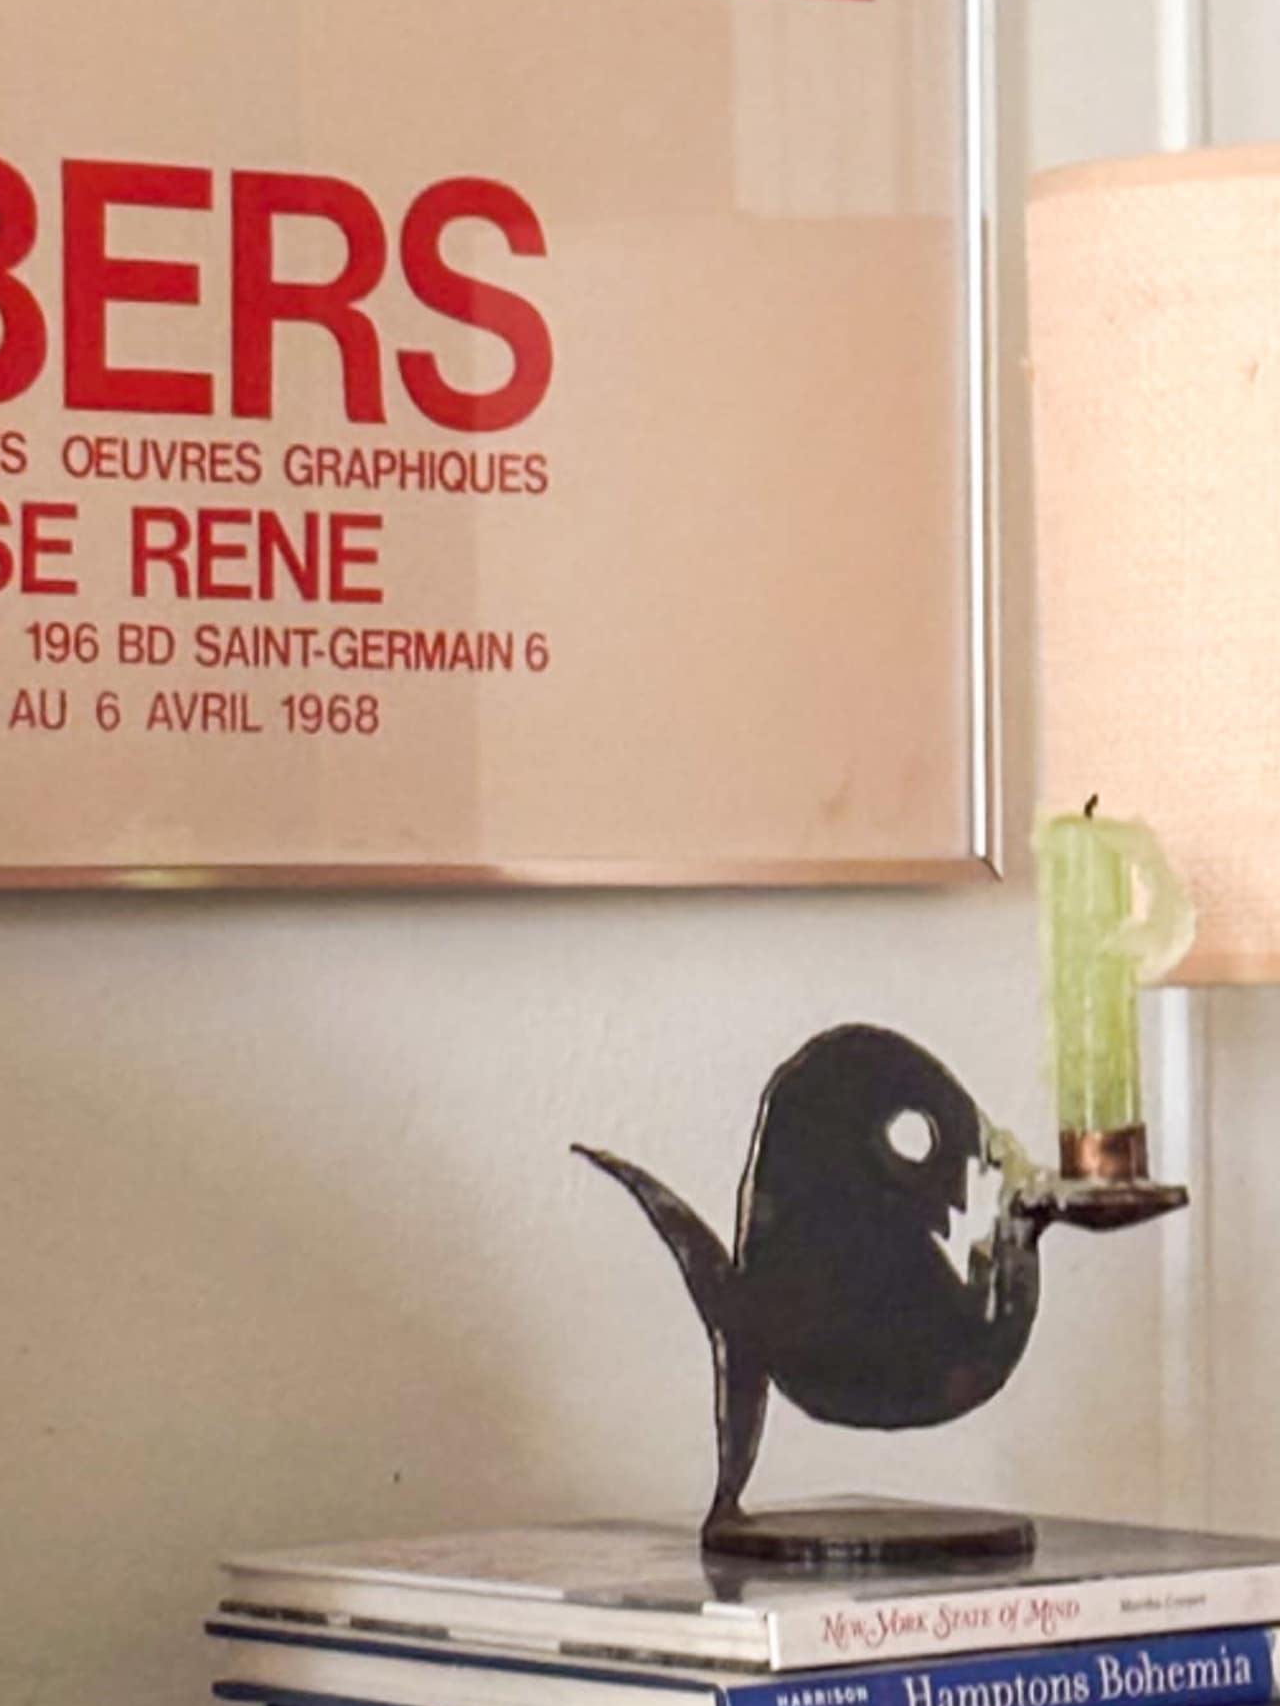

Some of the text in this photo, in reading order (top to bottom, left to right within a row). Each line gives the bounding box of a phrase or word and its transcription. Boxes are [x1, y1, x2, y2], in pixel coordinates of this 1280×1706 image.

[283, 444, 549, 494] GRAPHIQUES
[131, 506, 383, 603] RENE
[26, 621, 100, 663] 196
[116, 623, 177, 666] BD
[194, 624, 513, 670] SAINT-GERMAIN
[524, 631, 550, 673] 6
[9, 688, 69, 732] AU
[94, 690, 122, 733] 6
[145, 691, 263, 734] AVRIL
[283, 693, 380, 736] 1968
[1097, 1645, 1252, 1700] Bohemia
